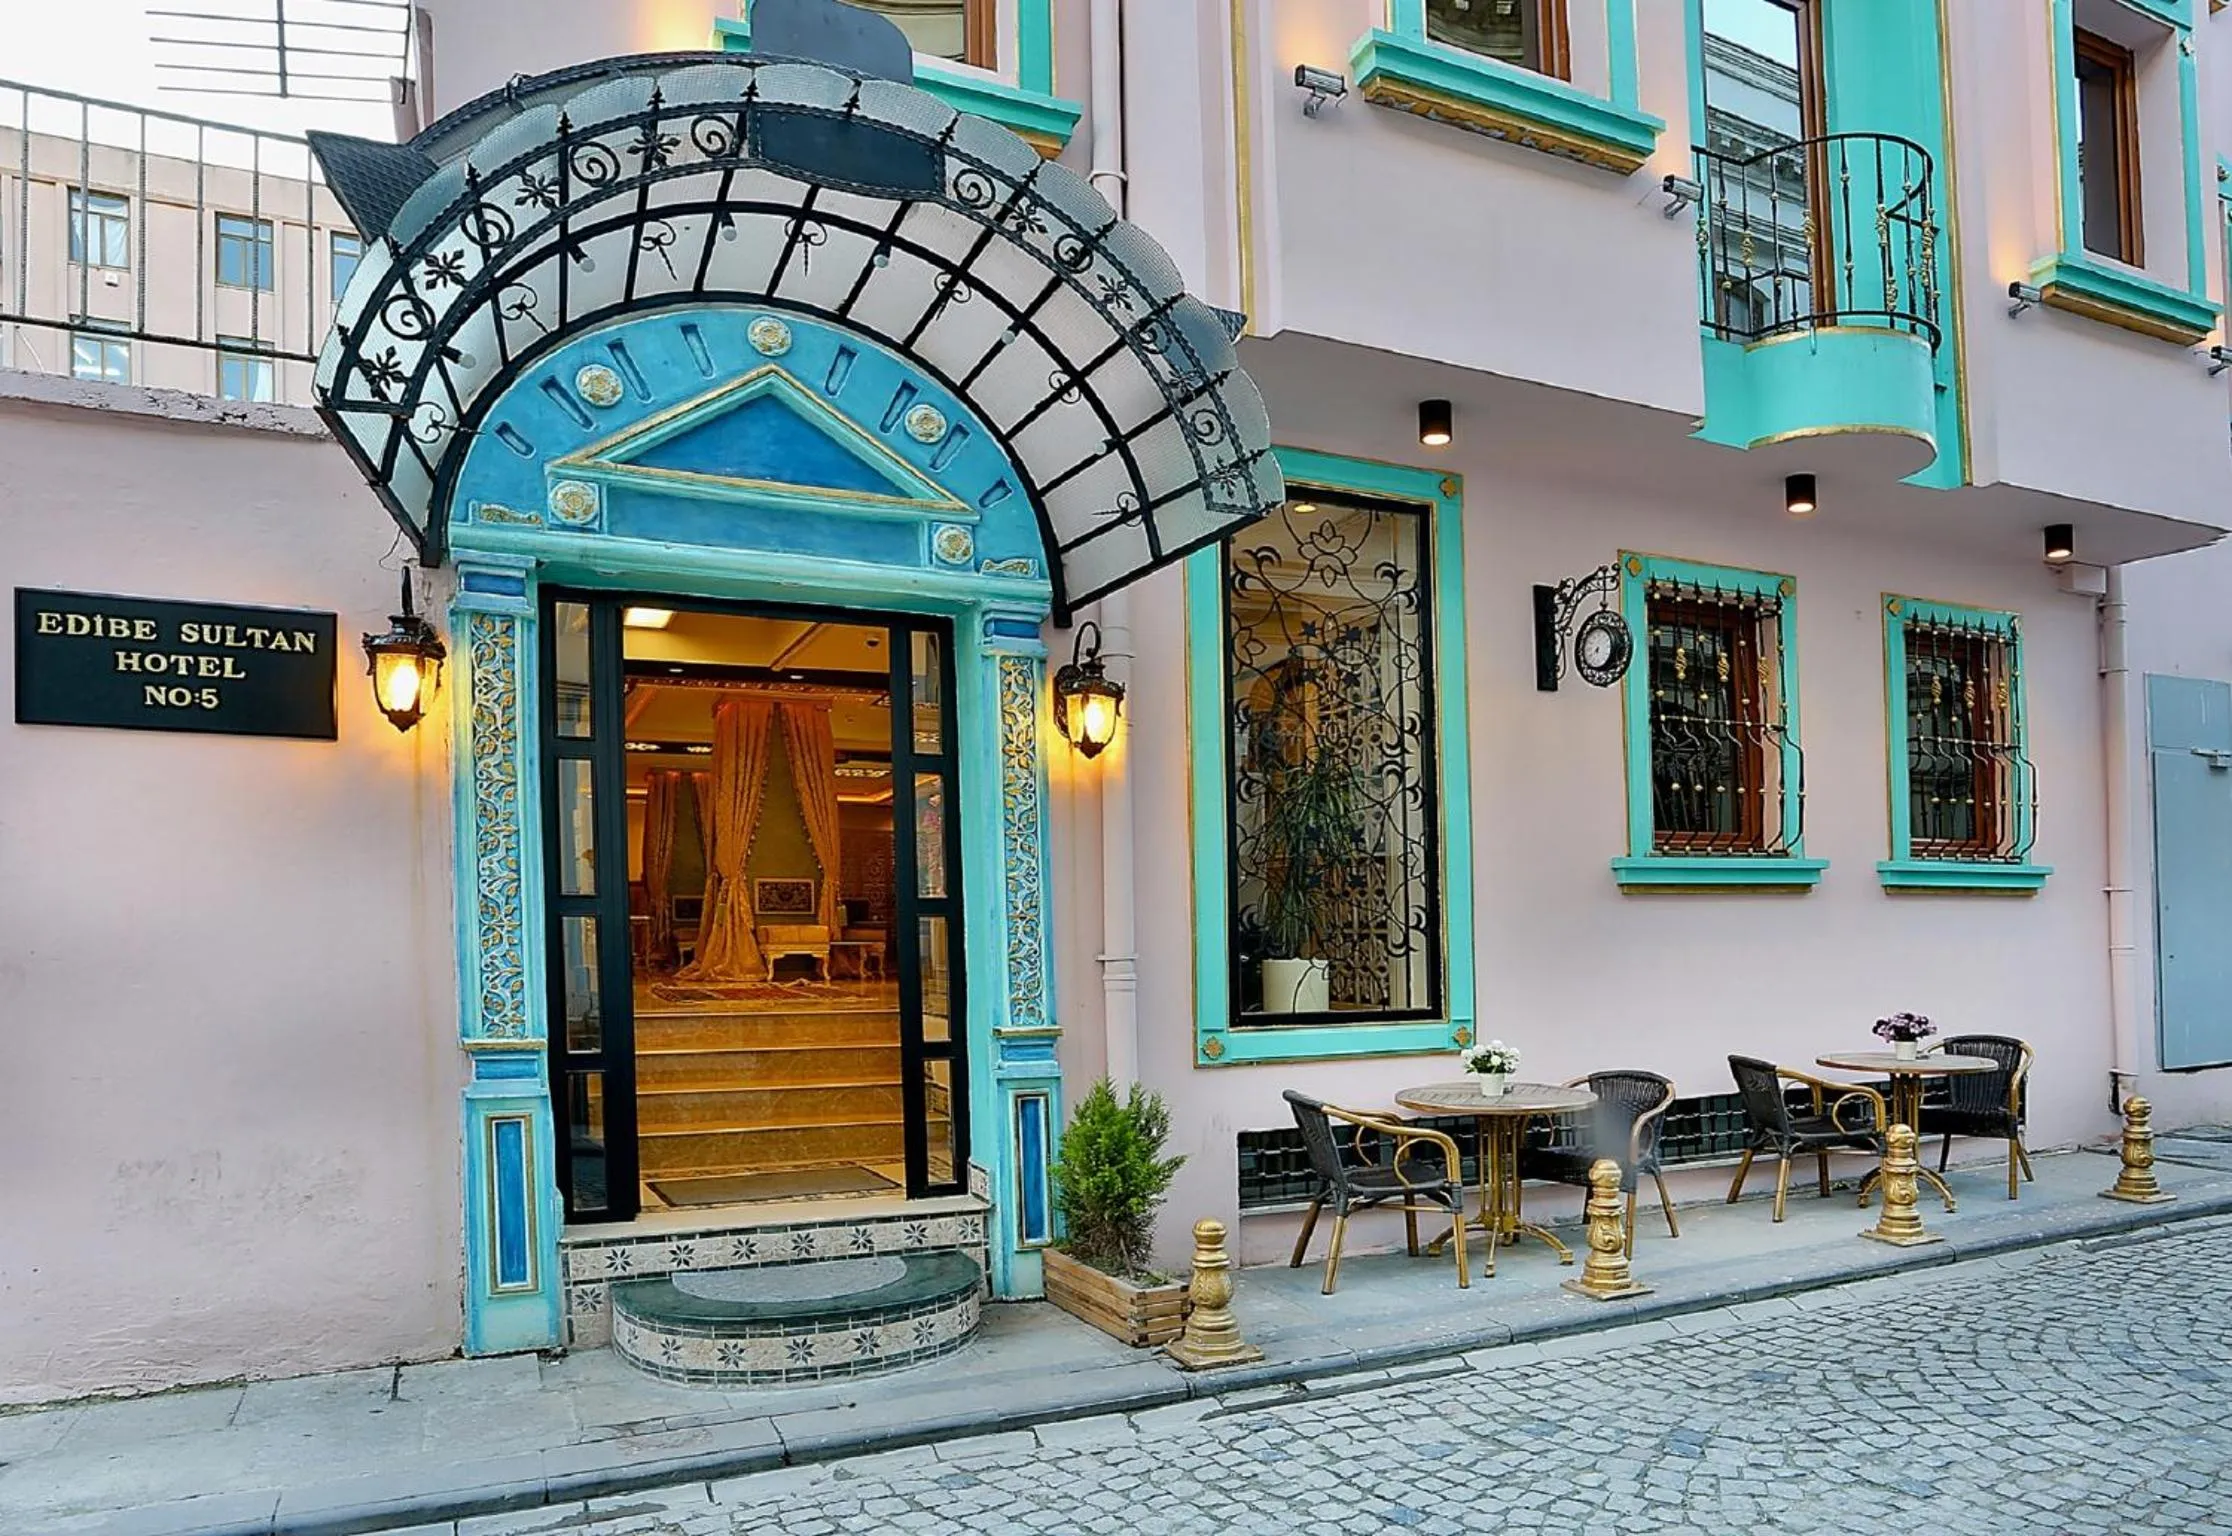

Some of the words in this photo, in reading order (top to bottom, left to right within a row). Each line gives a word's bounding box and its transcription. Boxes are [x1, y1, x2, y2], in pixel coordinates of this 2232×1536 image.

[180, 623, 317, 653] SULTAN
[115, 651, 246, 678] HOTEL
[144, 685, 219, 709] NO:5
